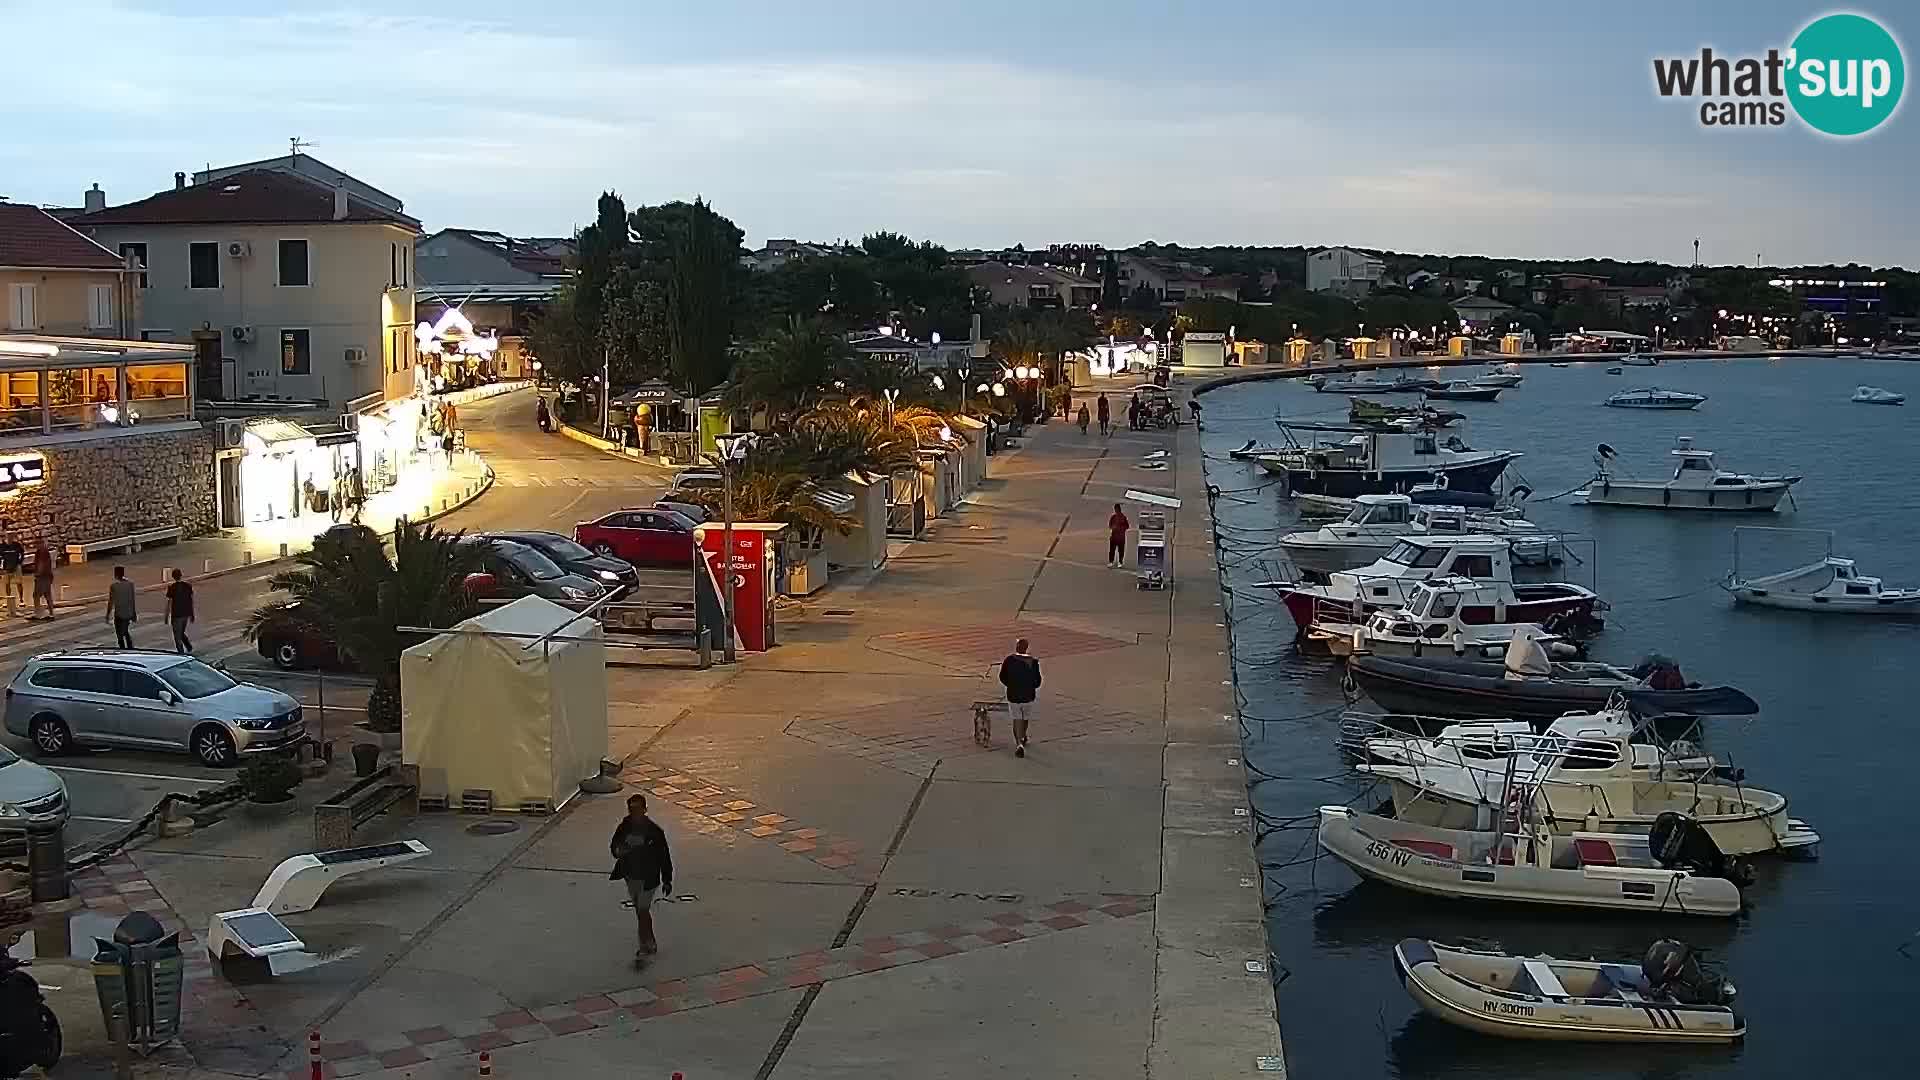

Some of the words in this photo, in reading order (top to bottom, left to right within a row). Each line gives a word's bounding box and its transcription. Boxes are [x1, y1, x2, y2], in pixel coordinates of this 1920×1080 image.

[1365, 840, 1391, 860] 456
[1390, 849, 1413, 867] NV
[1483, 1000, 1499, 1012] NV
